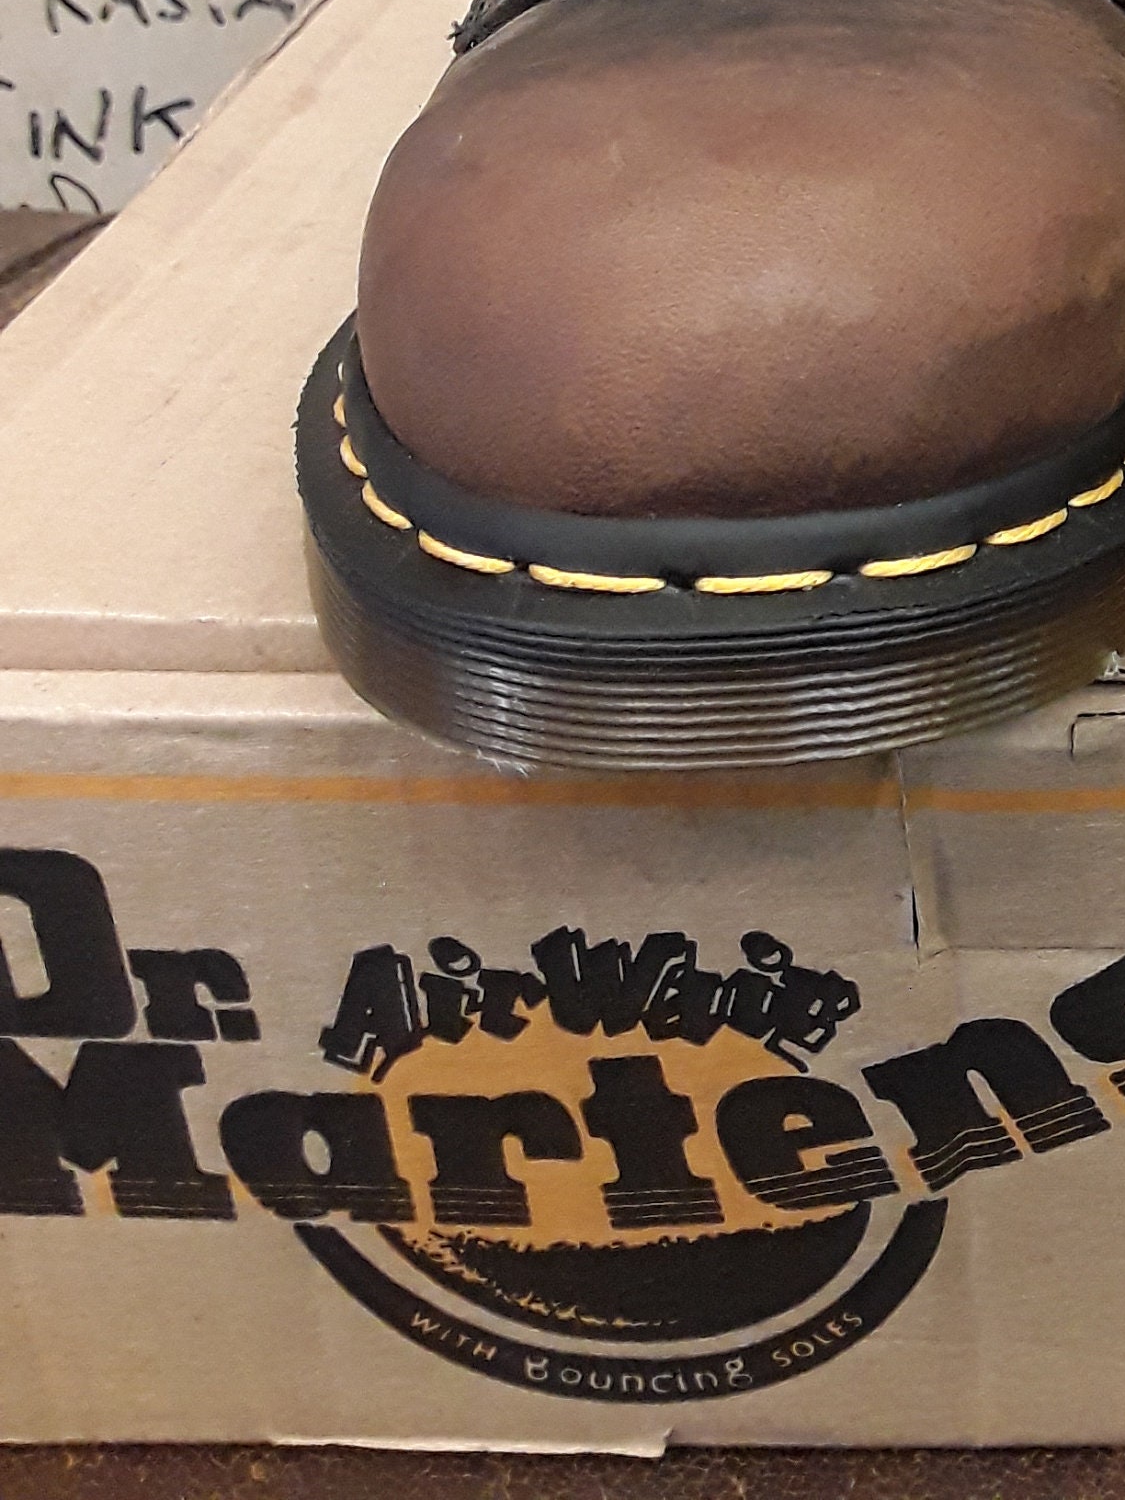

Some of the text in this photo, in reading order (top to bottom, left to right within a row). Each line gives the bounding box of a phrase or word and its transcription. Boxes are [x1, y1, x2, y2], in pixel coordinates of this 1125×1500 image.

[318, 924, 862, 1085] AirWair
[410, 1310, 865, 1394] WITH Bouncing SOLES
